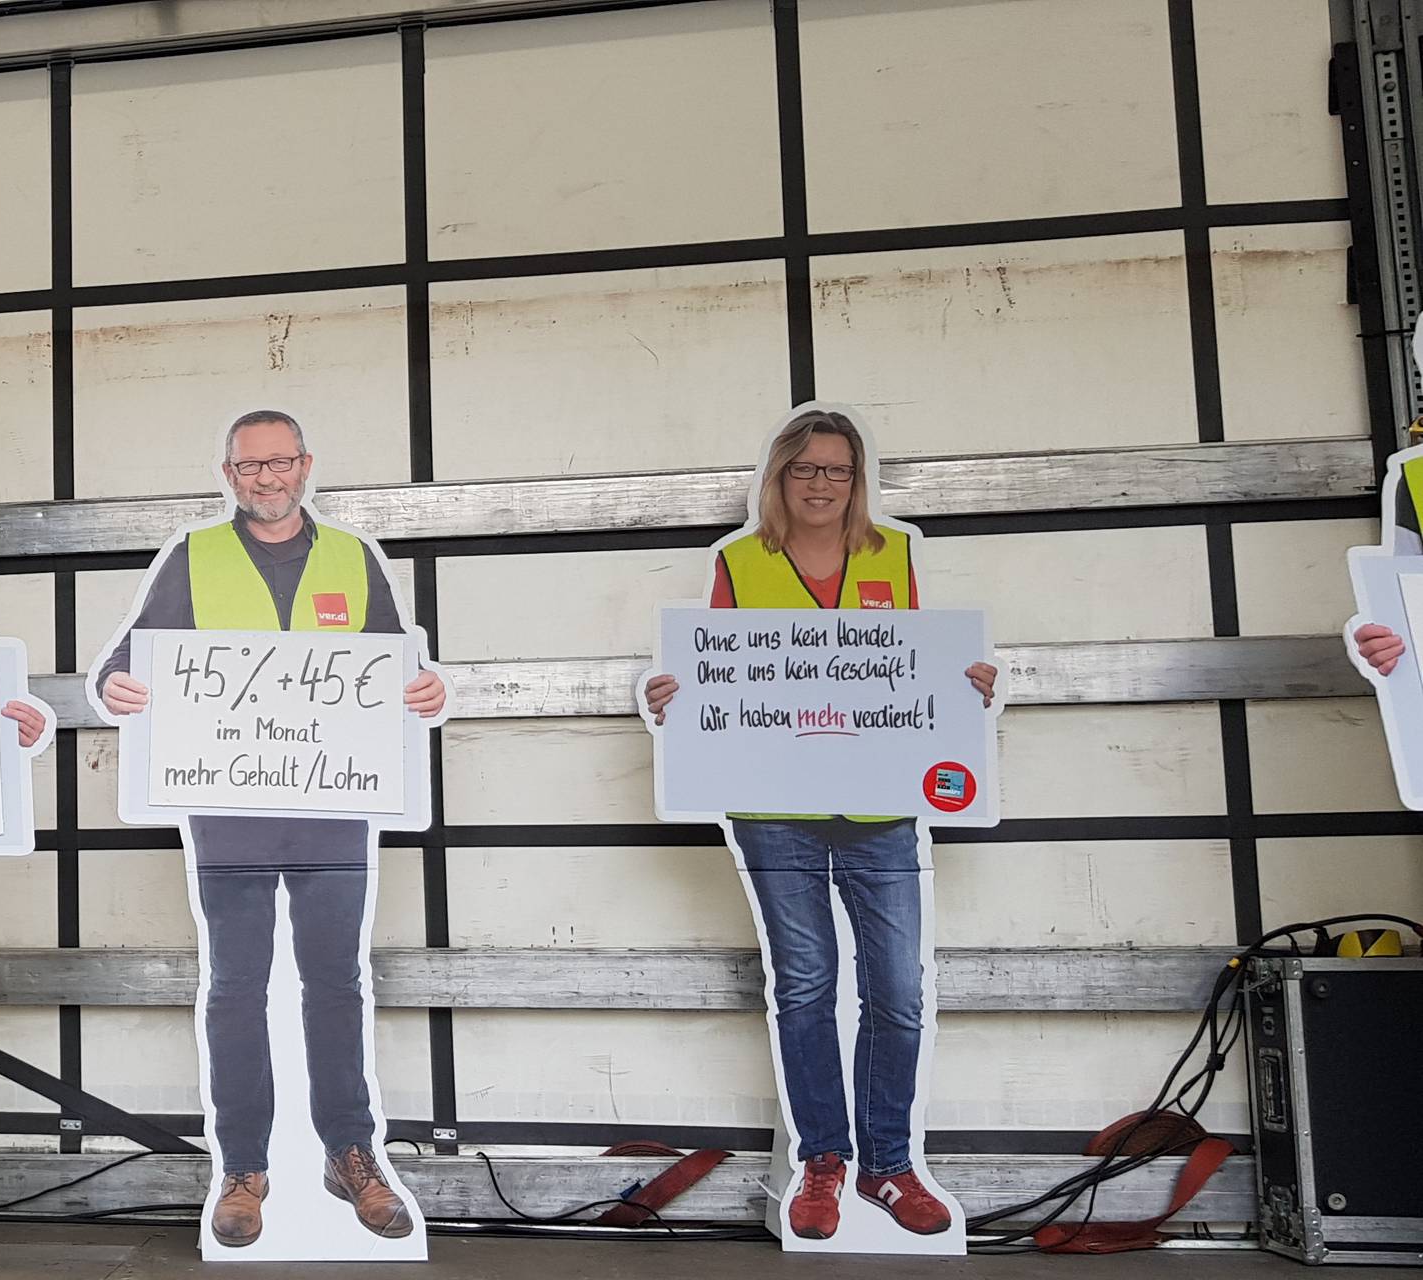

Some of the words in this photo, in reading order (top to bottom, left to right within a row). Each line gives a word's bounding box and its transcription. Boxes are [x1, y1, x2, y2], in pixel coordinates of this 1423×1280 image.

[862, 599, 892, 609] ver.di
[694, 627, 740, 652] Ohne
[747, 631, 781, 650] uns
[791, 622, 827, 647] kein
[837, 617, 904, 648] Handel.
[697, 660, 737, 684] Ohne
[747, 664, 775, 682] uns
[785, 656, 818, 680] kein
[826, 649, 916, 692] Geschäft!
[700, 704, 730, 732] Wir
[739, 698, 792, 728] haben
[797, 703, 847, 729] mehr
[852, 694, 935, 731] verdient!
[216, 719, 241, 741] im
[255, 716, 322, 744] Monat
[164, 757, 222, 787] mehr
